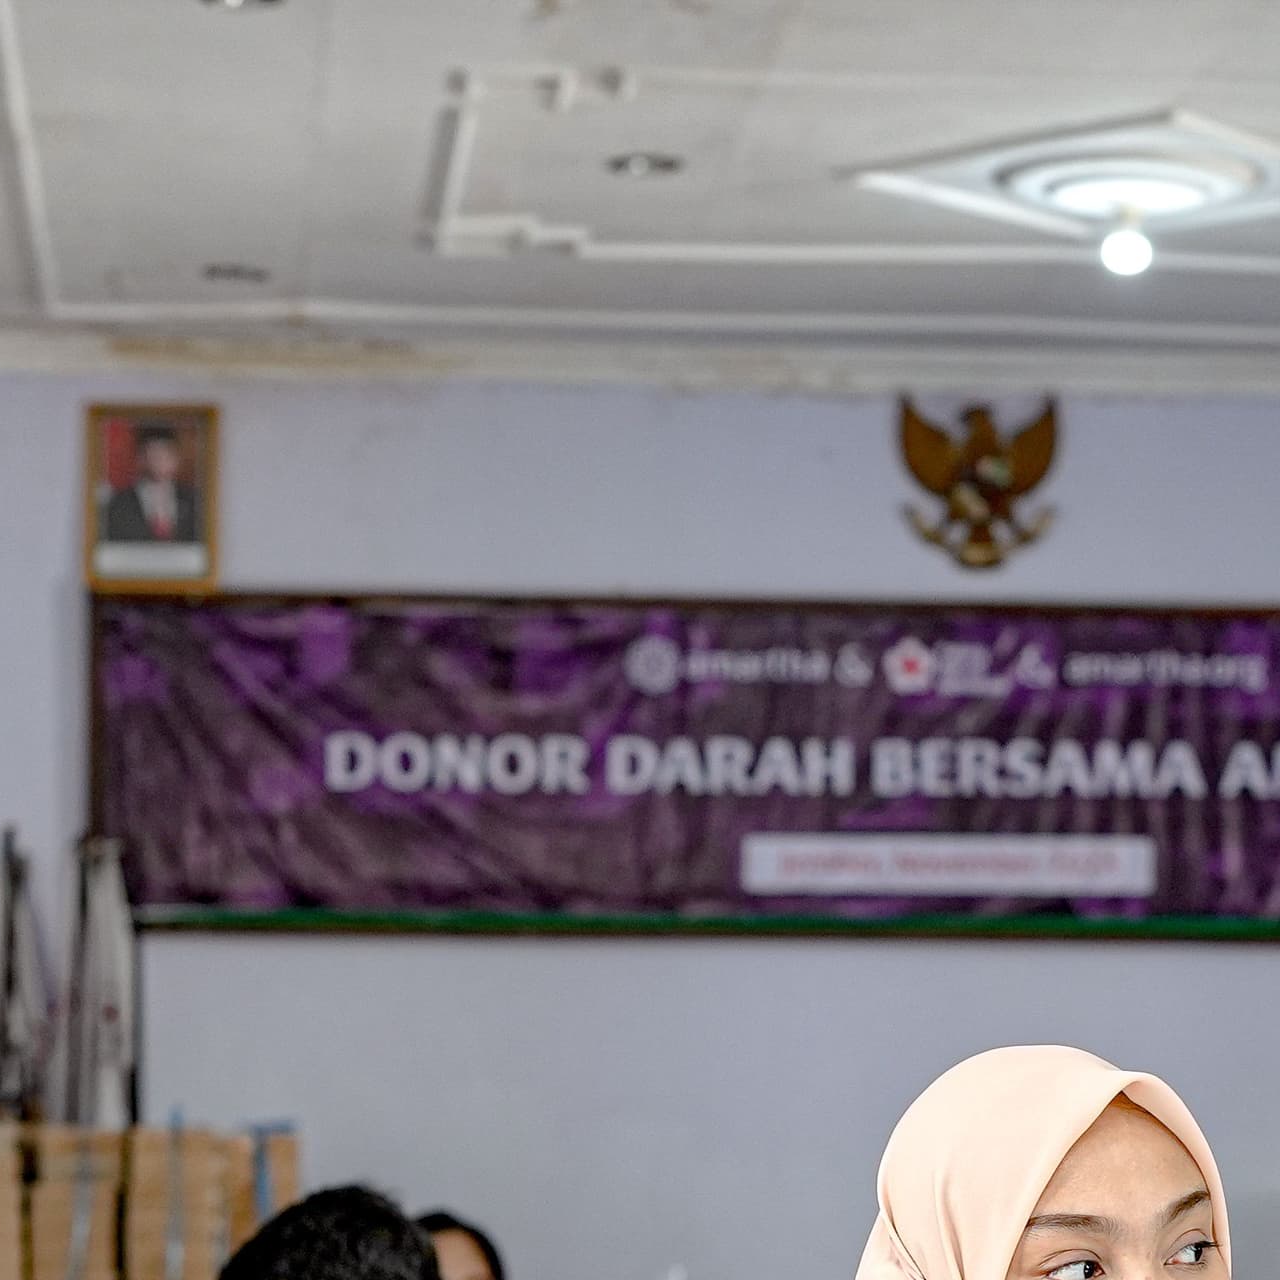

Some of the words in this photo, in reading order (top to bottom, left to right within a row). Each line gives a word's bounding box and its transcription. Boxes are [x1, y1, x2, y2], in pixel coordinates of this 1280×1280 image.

[324, 731, 590, 794] DONOR
[606, 734, 856, 795] DARAH
[871, 736, 1206, 798] BERSAMA
